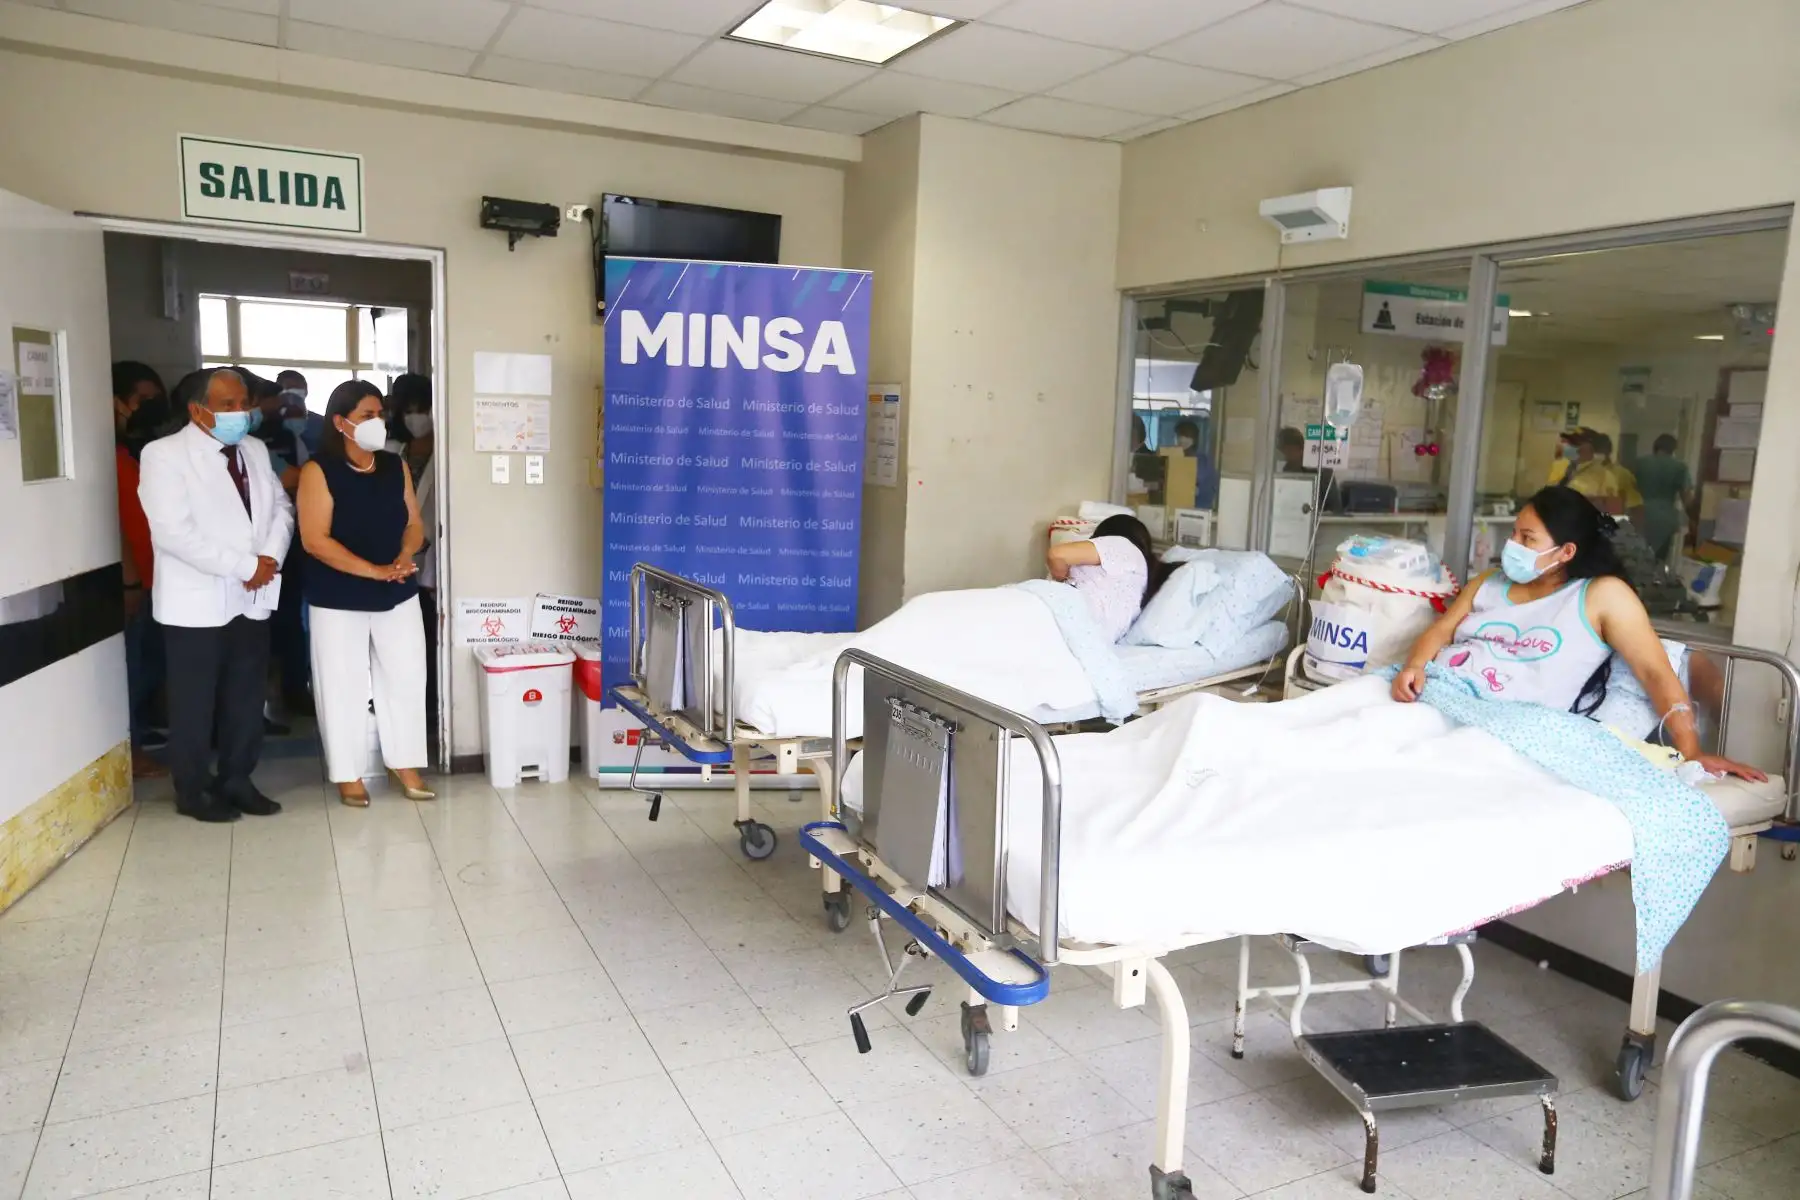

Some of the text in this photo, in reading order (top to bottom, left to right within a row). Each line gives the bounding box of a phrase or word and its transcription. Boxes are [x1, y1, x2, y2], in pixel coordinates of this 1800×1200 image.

[199, 162, 347, 211] SALIDA
[620, 309, 856, 375] MINSA
[611, 393, 731, 410] Ministerio de Salud
[743, 399, 859, 416] Ministerio de Salud
[610, 452, 729, 468] Ministerio de Salud
[741, 457, 857, 473] Ministerio de Salud
[610, 511, 727, 527] Ministerio de Salud
[739, 516, 854, 530] Ministerio de Salud
[692, 571, 725, 584] Salud
[738, 573, 852, 588] Ministerio de Salud
[541, 604, 597, 615] BIOCONTAMINADO
[532, 631, 558, 640] RIESGO
[1310, 617, 1368, 654] MINSA
[528, 691, 536, 700] B
